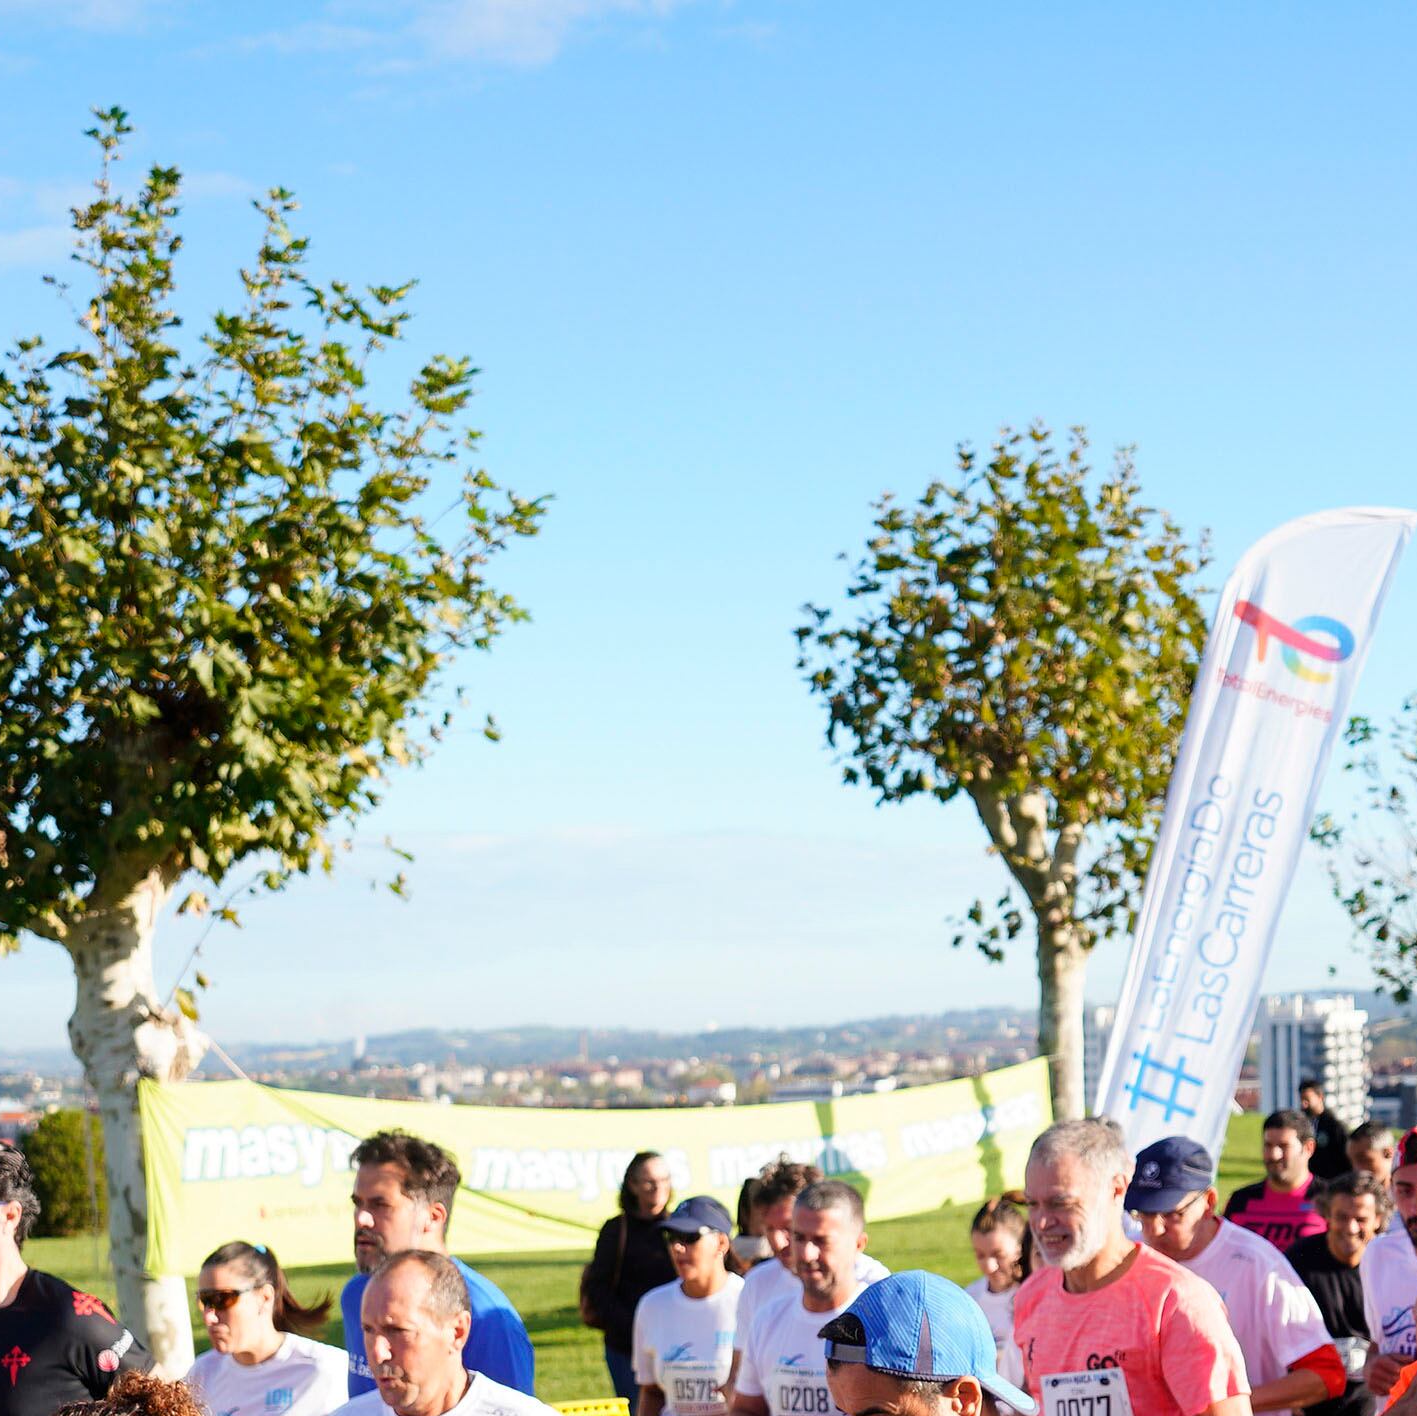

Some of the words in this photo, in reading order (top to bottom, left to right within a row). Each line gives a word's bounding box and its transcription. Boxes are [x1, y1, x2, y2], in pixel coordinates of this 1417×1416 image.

[1216, 667, 1334, 722] TotalEnergies
[1175, 787, 1283, 1046] LasCarreras
[780, 1385, 830, 1413] 0208
